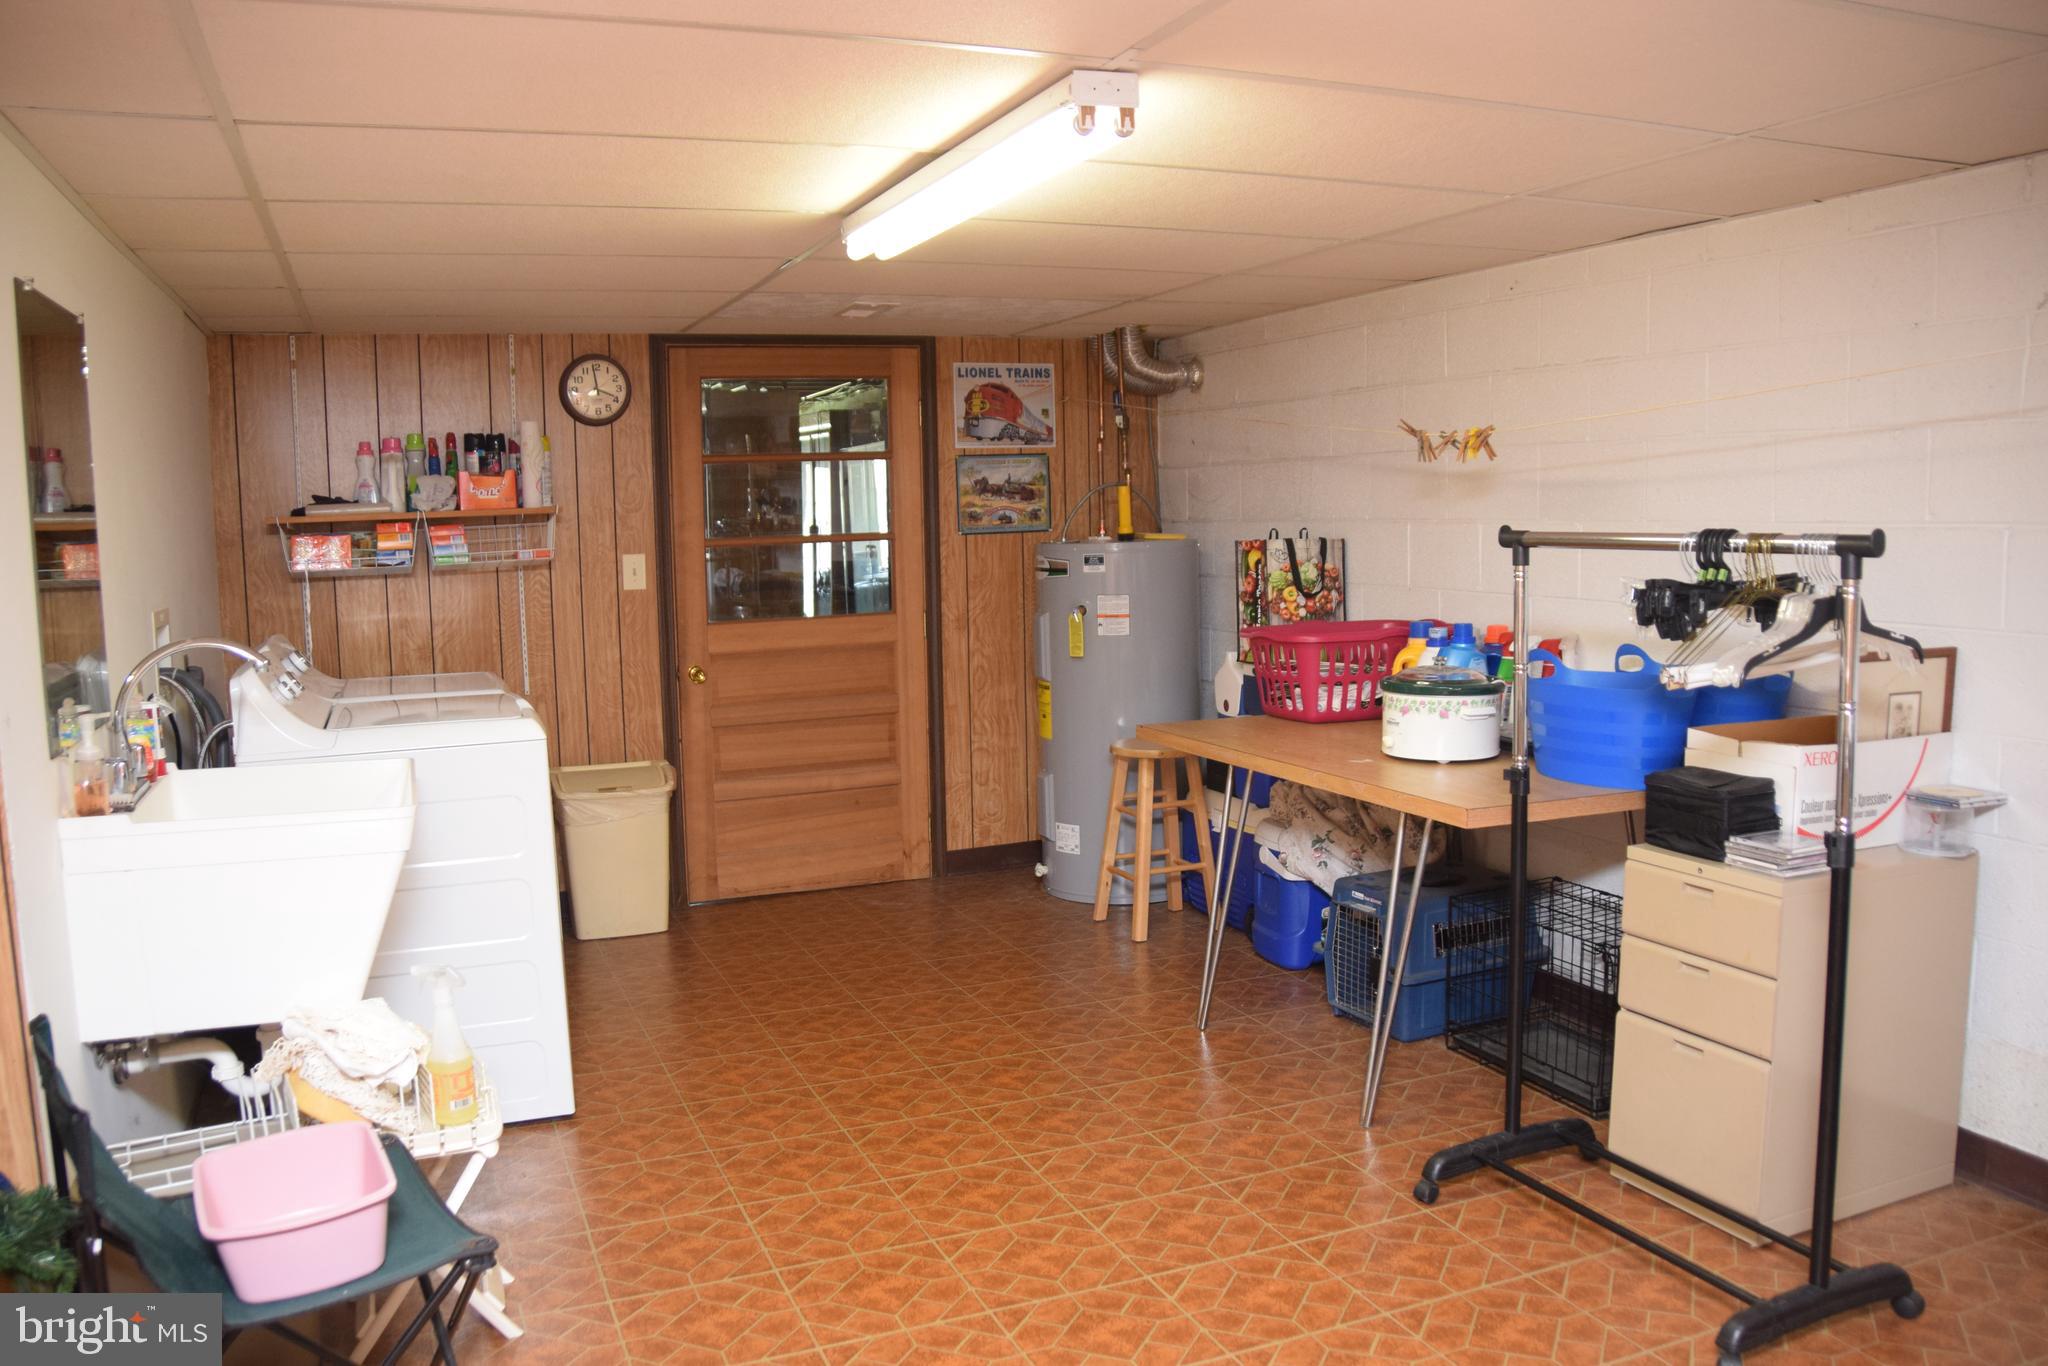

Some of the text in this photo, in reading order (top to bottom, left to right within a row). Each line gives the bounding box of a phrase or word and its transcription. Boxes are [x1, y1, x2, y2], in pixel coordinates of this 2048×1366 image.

[582, 367, 589, 375] 11
[957, 367, 1051, 378] LIONEL TRAINS
[574, 376, 584, 384] 10
[612, 374, 619, 383] 2
[616, 384, 623, 393] 3
[612, 395, 619, 404] 4
[595, 407, 602, 416] 6
[605, 404, 612, 412] 5
[1804, 750, 1839, 767] XERO
